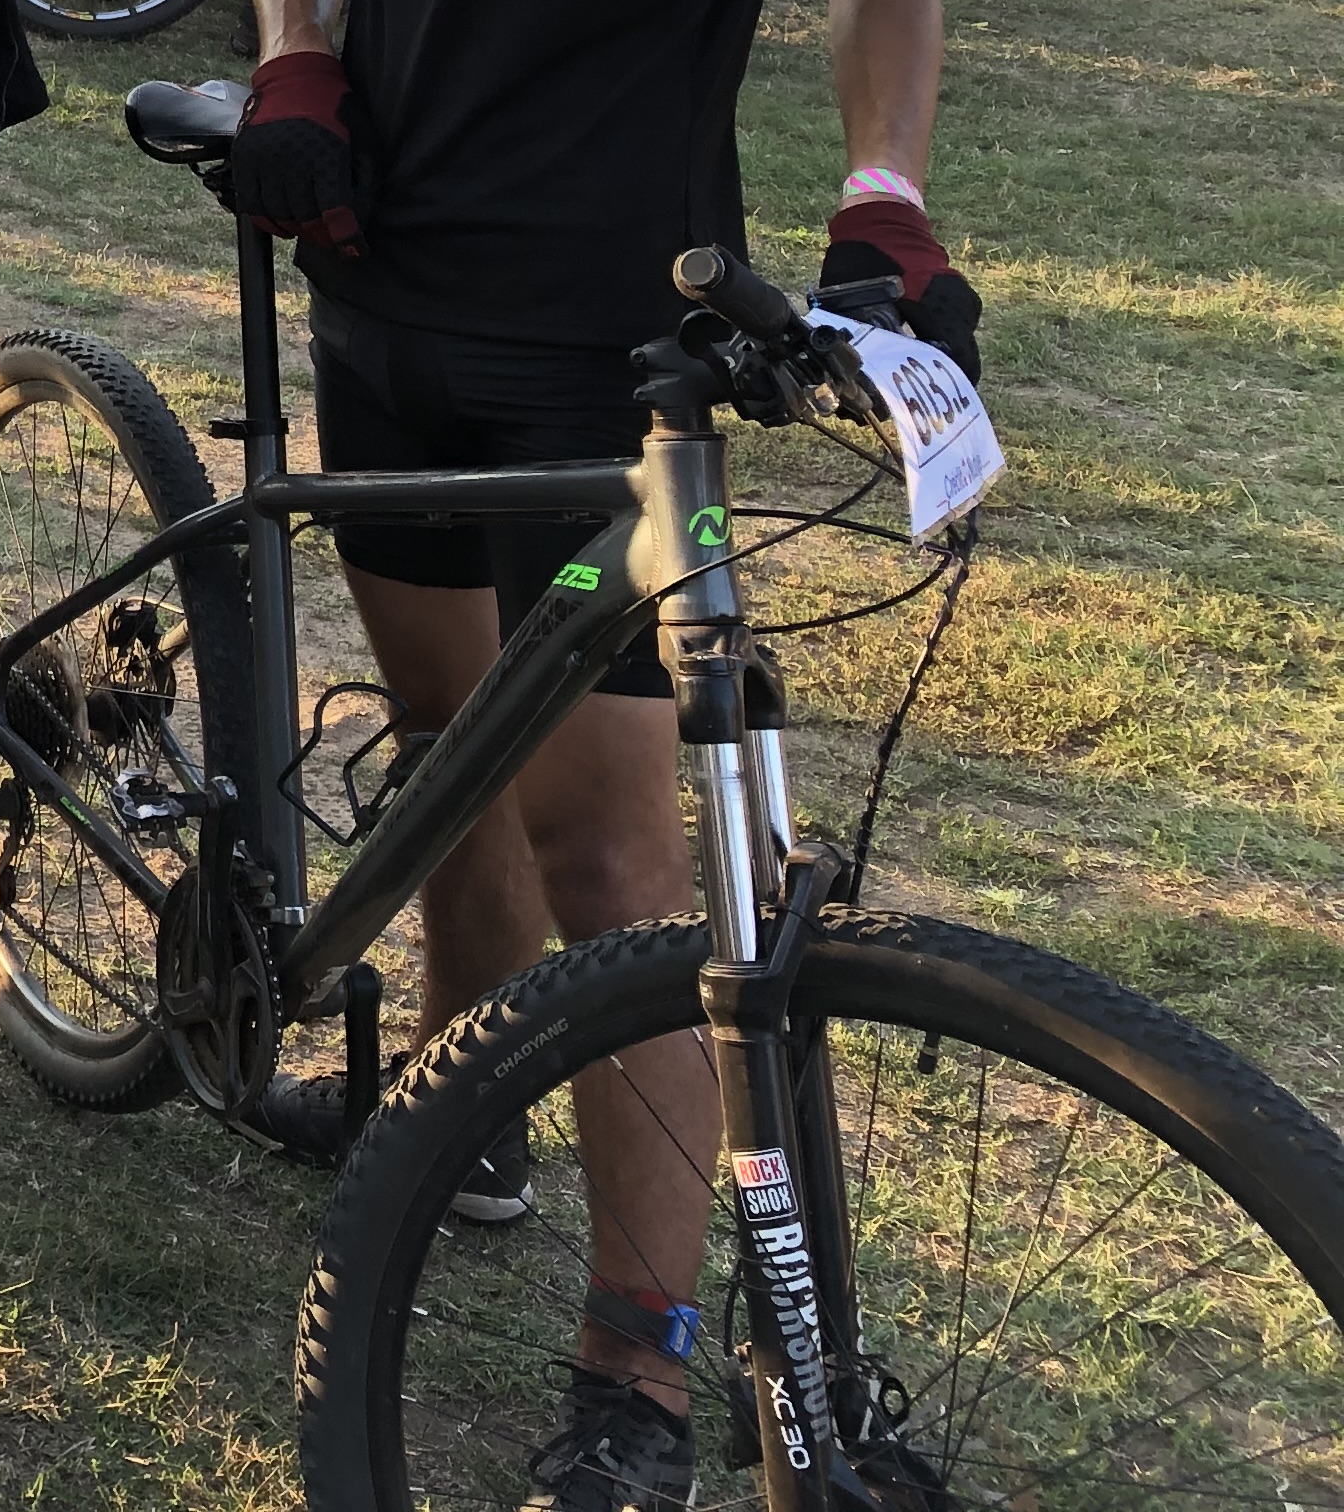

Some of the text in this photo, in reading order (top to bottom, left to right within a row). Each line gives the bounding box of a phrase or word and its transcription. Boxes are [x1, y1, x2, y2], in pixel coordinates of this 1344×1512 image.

[892, 356, 971, 447] 603.2
[494, 1017, 570, 1079] CHAOYANG
[739, 1156, 785, 1185] ROCK
[746, 1184, 793, 1215] SHOX
[765, 1377, 812, 1471] XC 30
